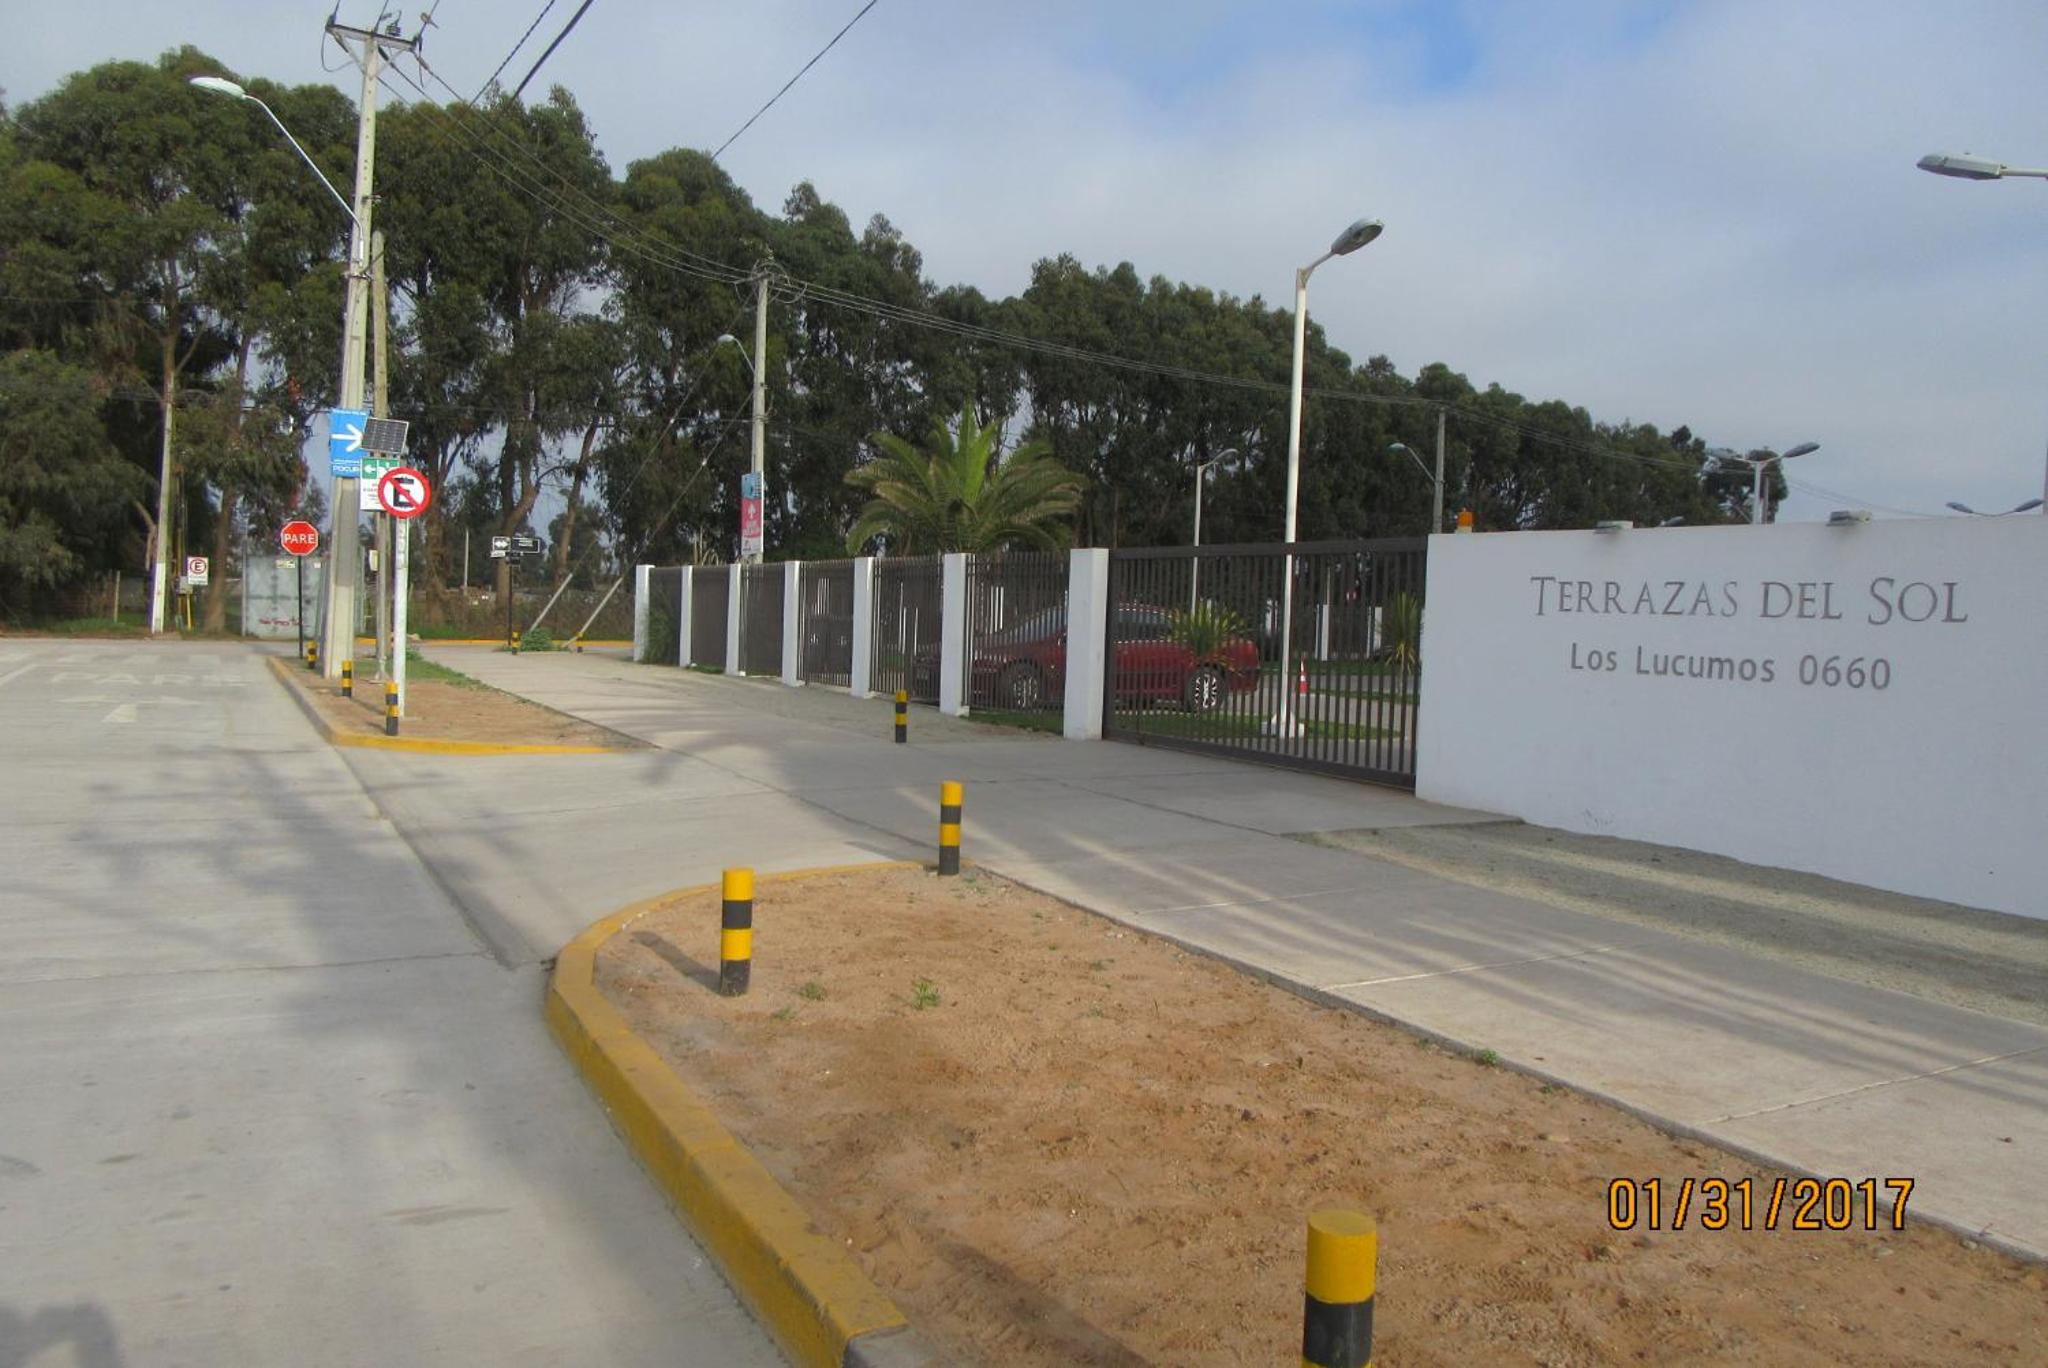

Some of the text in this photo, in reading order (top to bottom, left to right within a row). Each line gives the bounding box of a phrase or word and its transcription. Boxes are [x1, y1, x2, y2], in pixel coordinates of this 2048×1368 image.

[284, 533, 316, 545] PARE
[1530, 576, 1968, 625] TERRAZAS DEL SOL
[50, 672, 252, 687] PARE
[1570, 642, 1891, 690] Los Lucumos 0660
